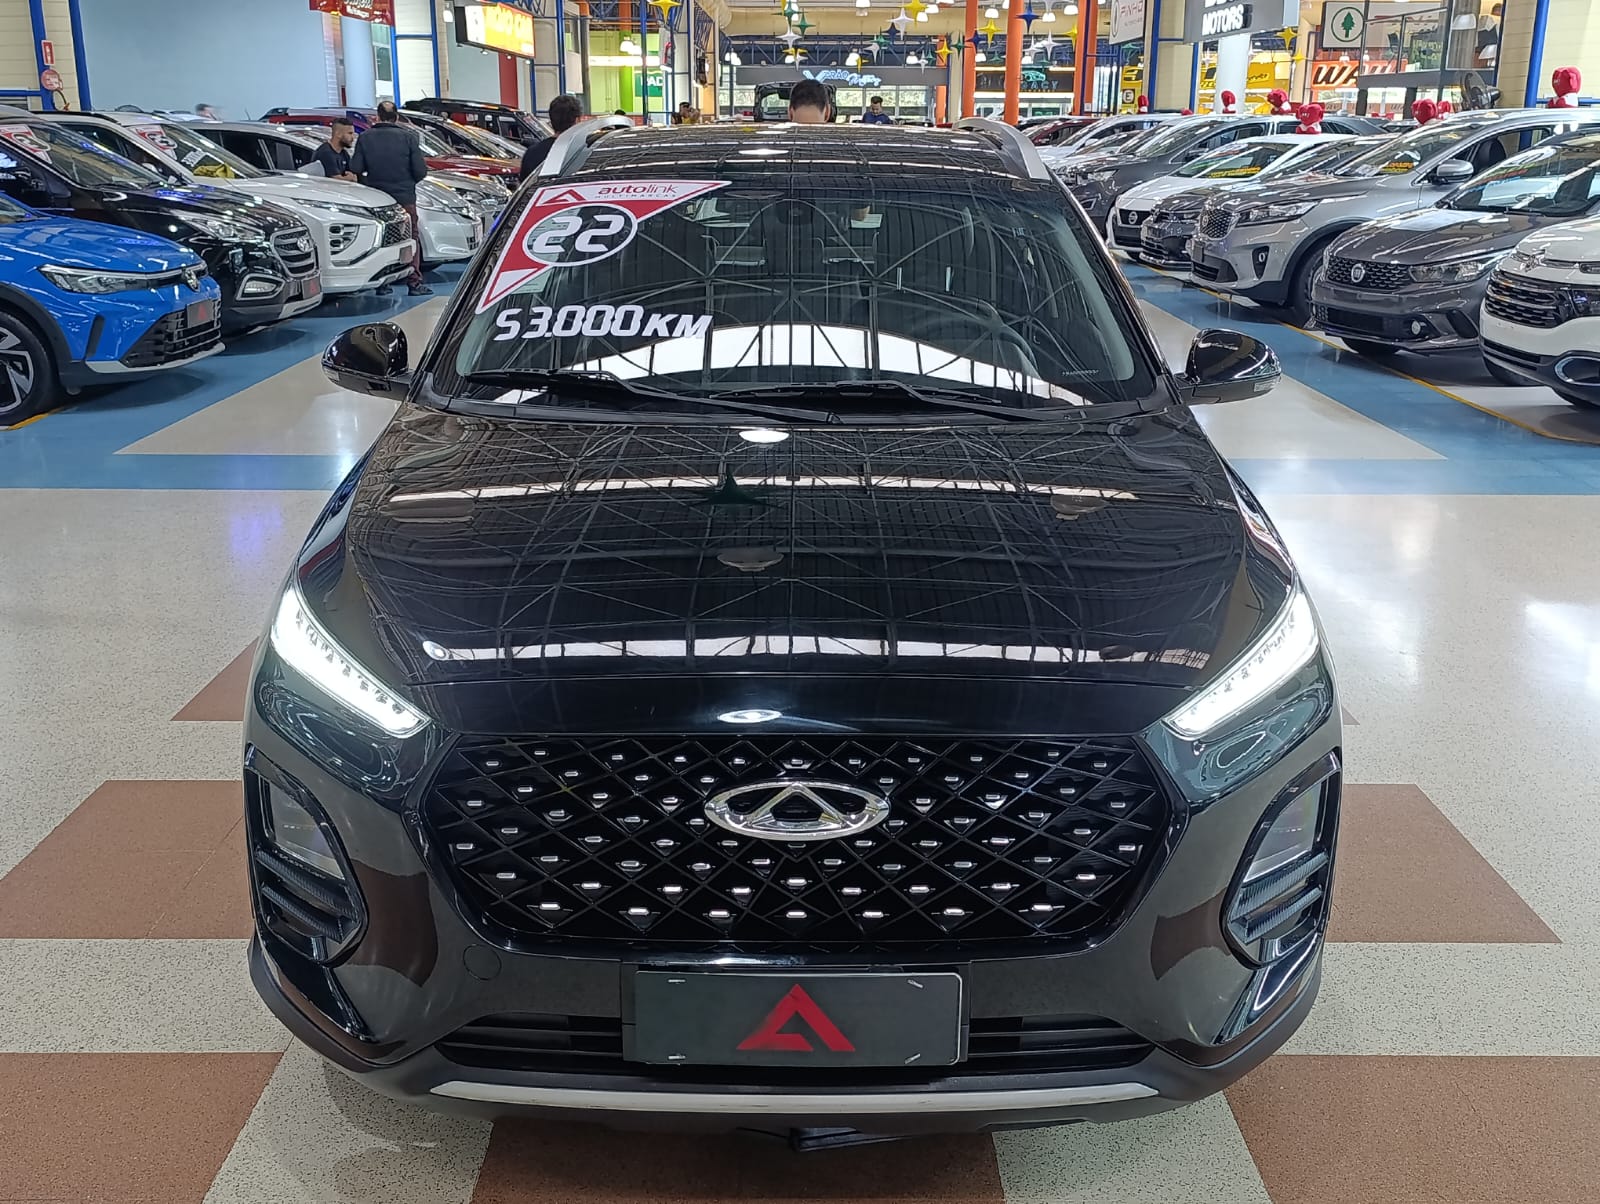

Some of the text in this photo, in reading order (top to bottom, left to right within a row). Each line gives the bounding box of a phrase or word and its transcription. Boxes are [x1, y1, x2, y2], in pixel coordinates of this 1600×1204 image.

[1202, 4, 1245, 36] MOTORS
[598, 184, 679, 195] autolink
[532, 214, 625, 253] 22
